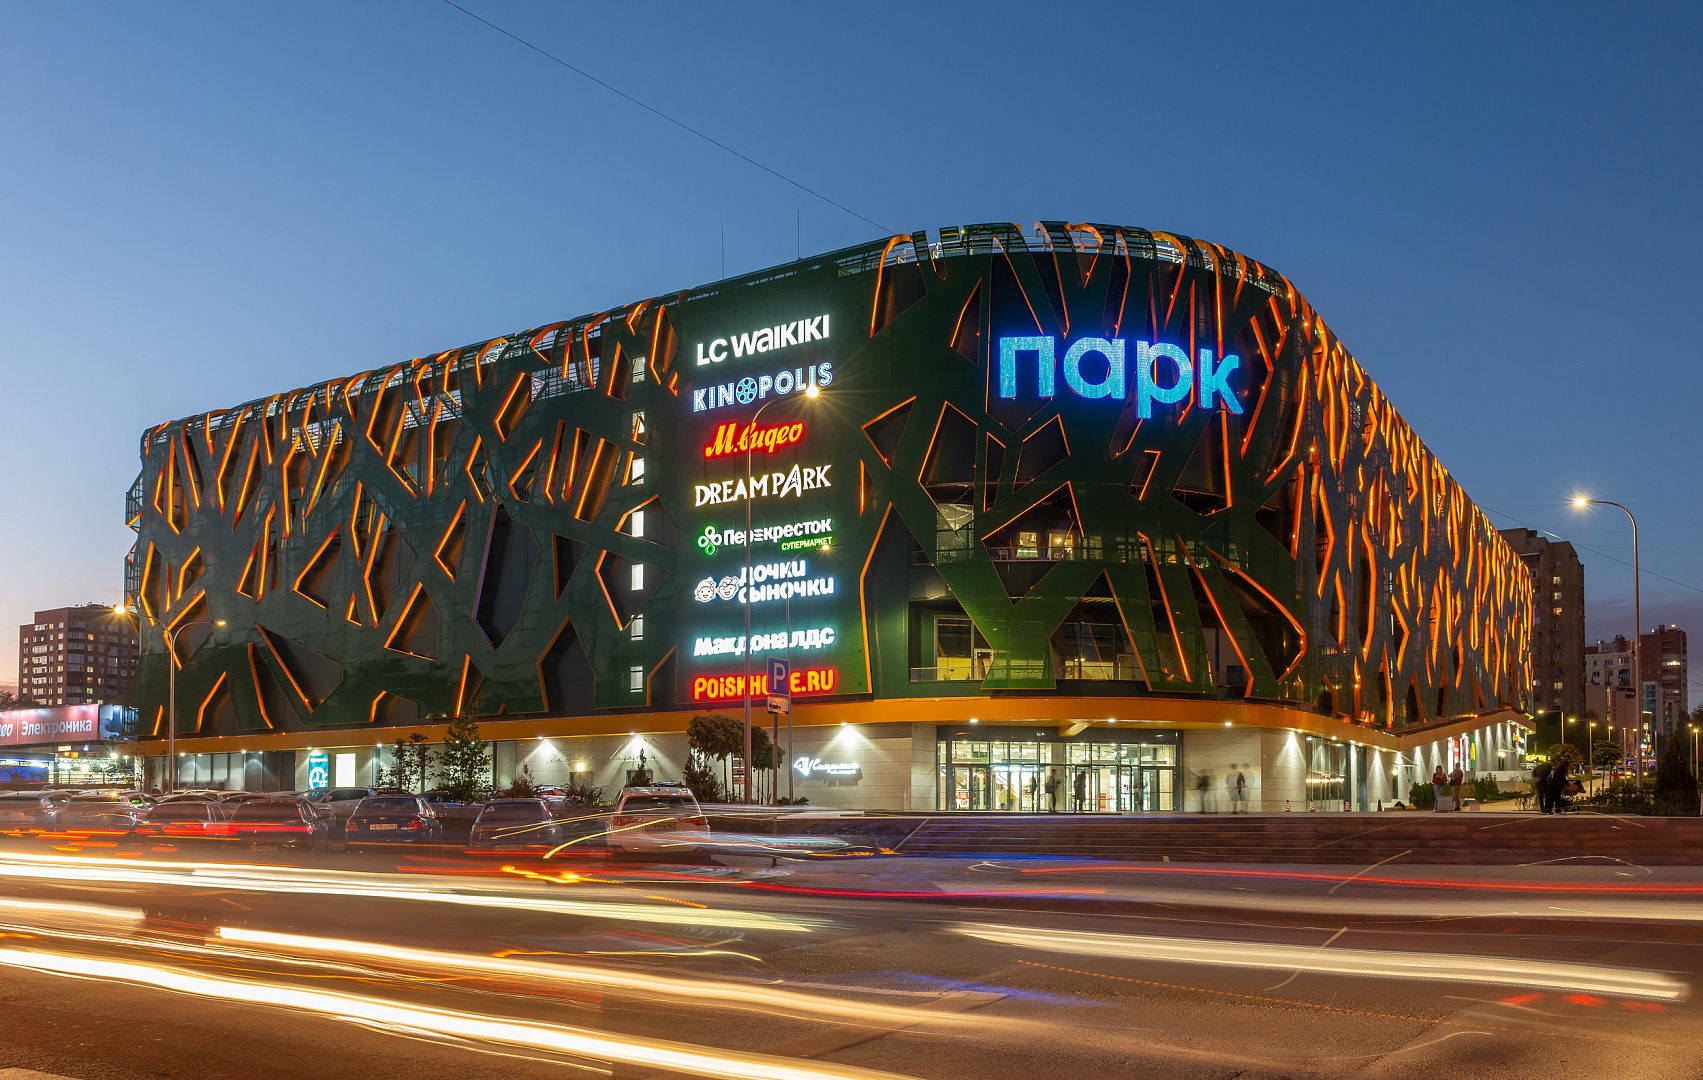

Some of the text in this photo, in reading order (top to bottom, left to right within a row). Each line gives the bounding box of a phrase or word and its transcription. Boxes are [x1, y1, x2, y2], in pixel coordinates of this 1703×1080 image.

[697, 338, 728, 366] LC
[693, 362, 833, 412] KINOPOLIS
[694, 463, 832, 507] DREAM PARK
[723, 518, 833, 547] Перекресток
[781, 536, 833, 551] СУПЕРМАРКЕТ
[773, 662, 786, 690] P
[21, 719, 92, 740] Электроника
